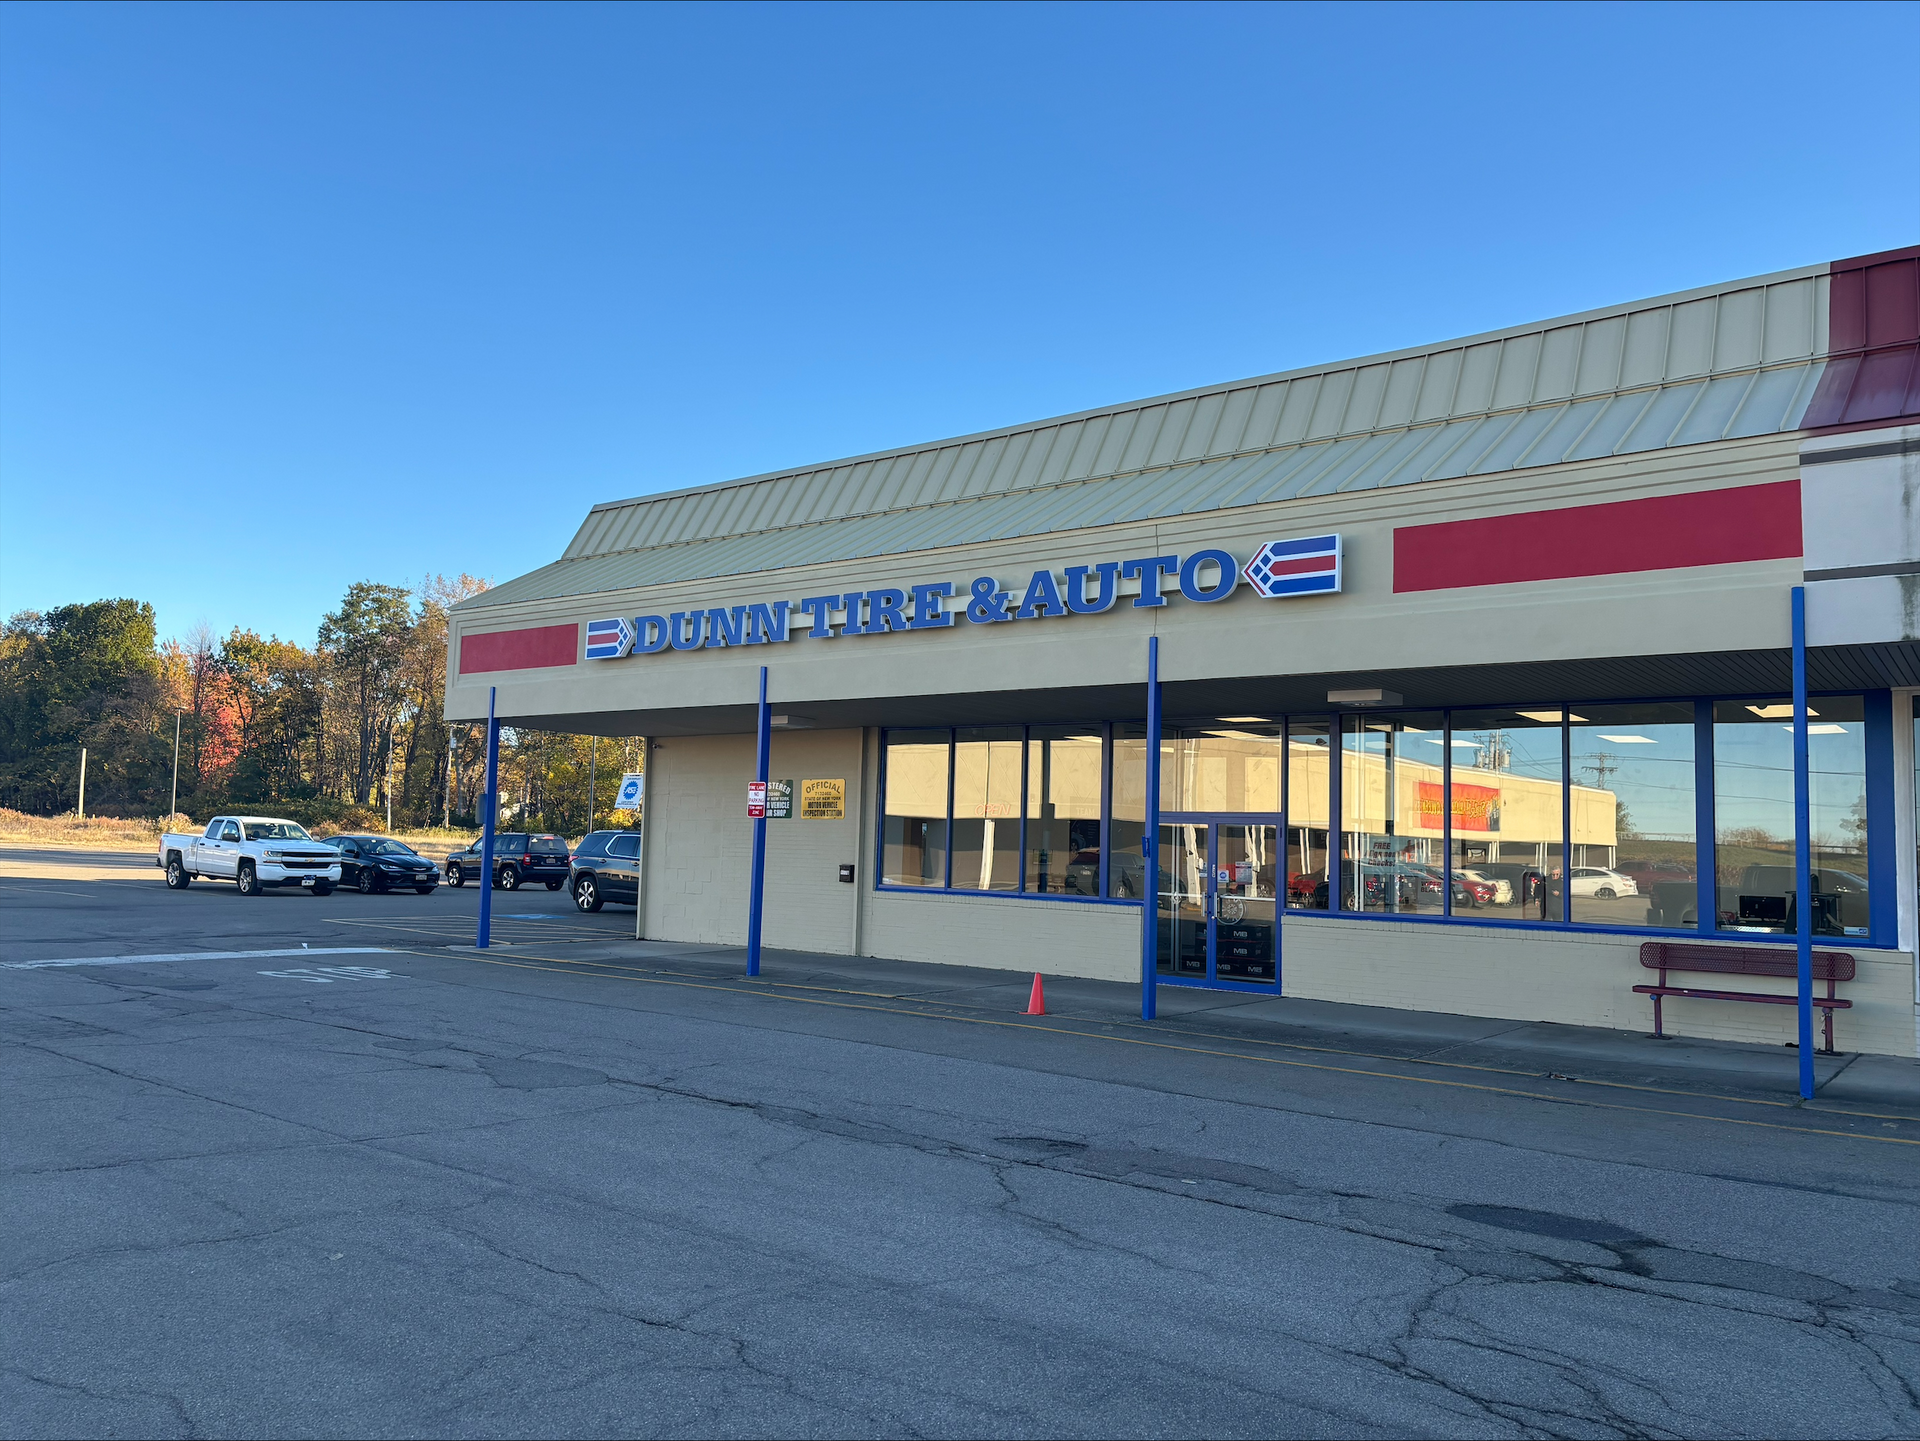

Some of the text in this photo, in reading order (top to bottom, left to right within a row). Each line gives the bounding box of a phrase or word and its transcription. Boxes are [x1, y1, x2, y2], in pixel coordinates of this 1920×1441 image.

[632, 548, 1239, 655] DUNN TIRE & AUTO
[806, 781, 840, 794] OFFICIAL
[974, 803, 1011, 816] OPEN
[1076, 808, 1095, 817] TEAM
[1373, 842, 1391, 850] FREE
[1233, 930, 1248, 938] MB
[1233, 947, 1248, 955] MB
